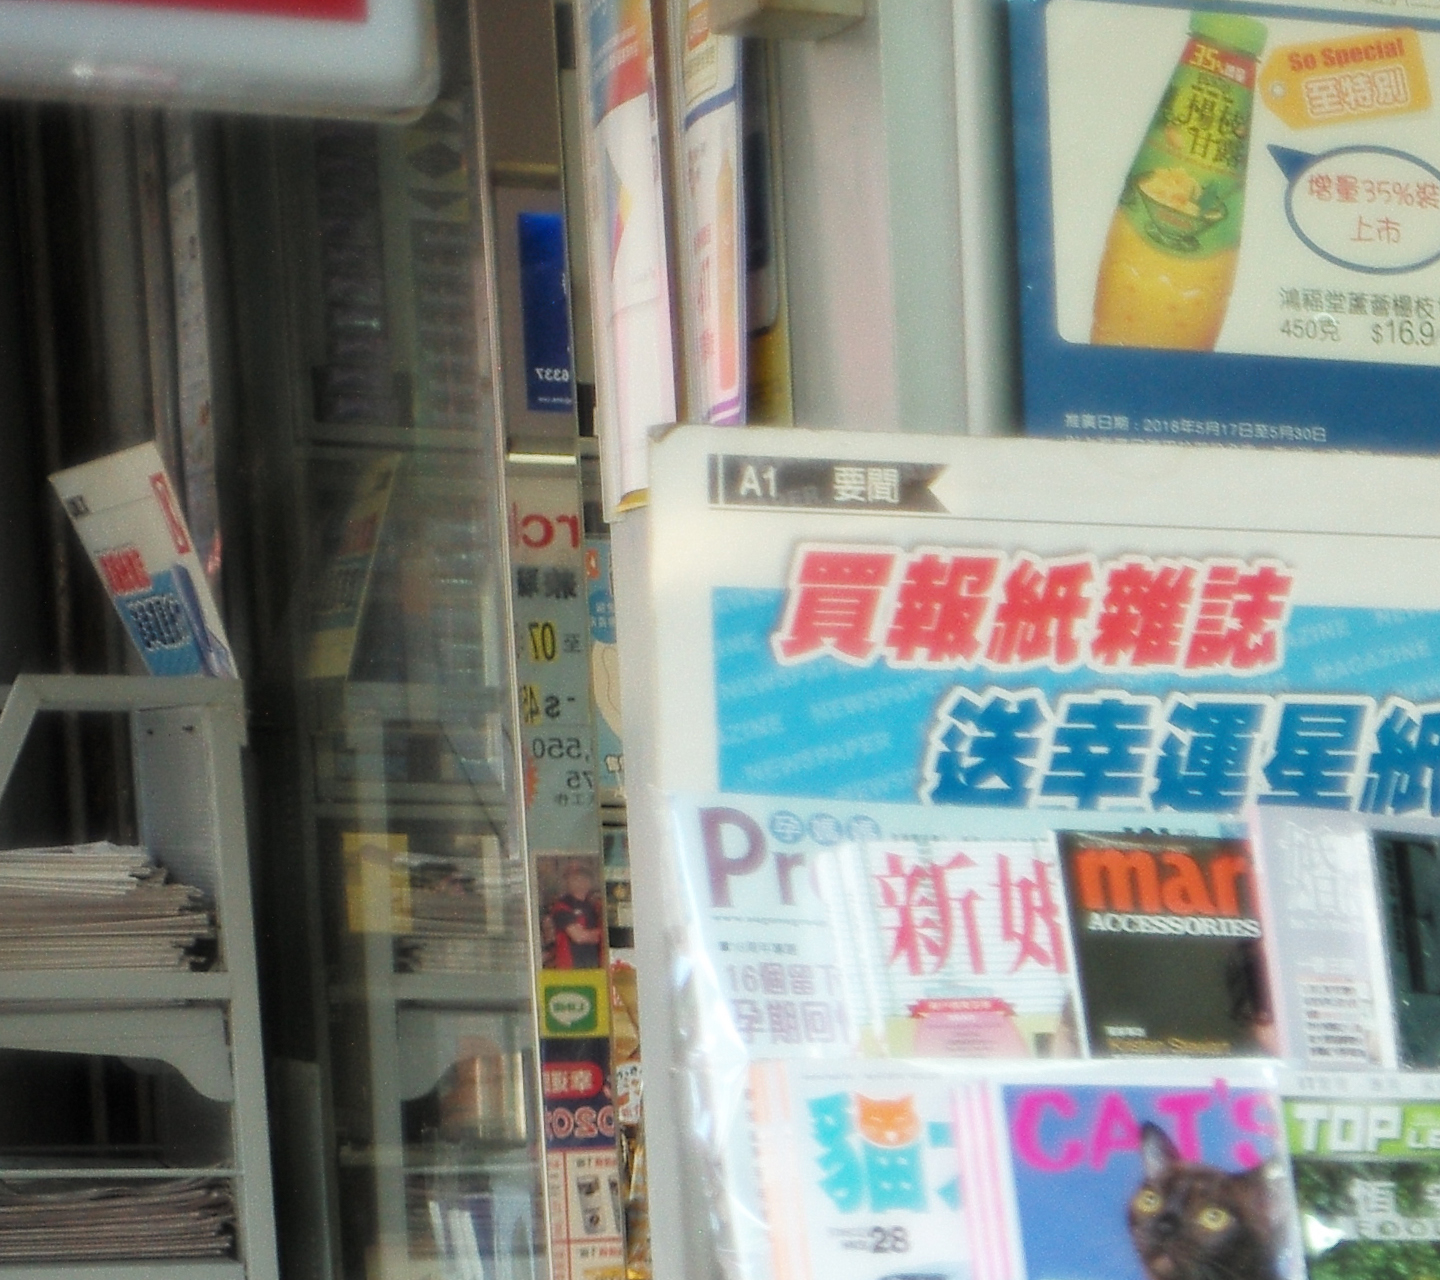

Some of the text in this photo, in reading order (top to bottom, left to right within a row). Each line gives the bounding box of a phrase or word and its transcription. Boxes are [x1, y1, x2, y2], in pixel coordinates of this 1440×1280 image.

[1288, 37, 1406, 72] So Special
[1303, 64, 1411, 120] 至特別
[1350, 217, 1402, 244] 上市
[738, 463, 901, 504] A1 要聞
[780, 548, 1293, 664] 買報紙雜誌
[1088, 912, 1263, 940] ACCESSORIES
[1292, 1105, 1403, 1152] TOP
